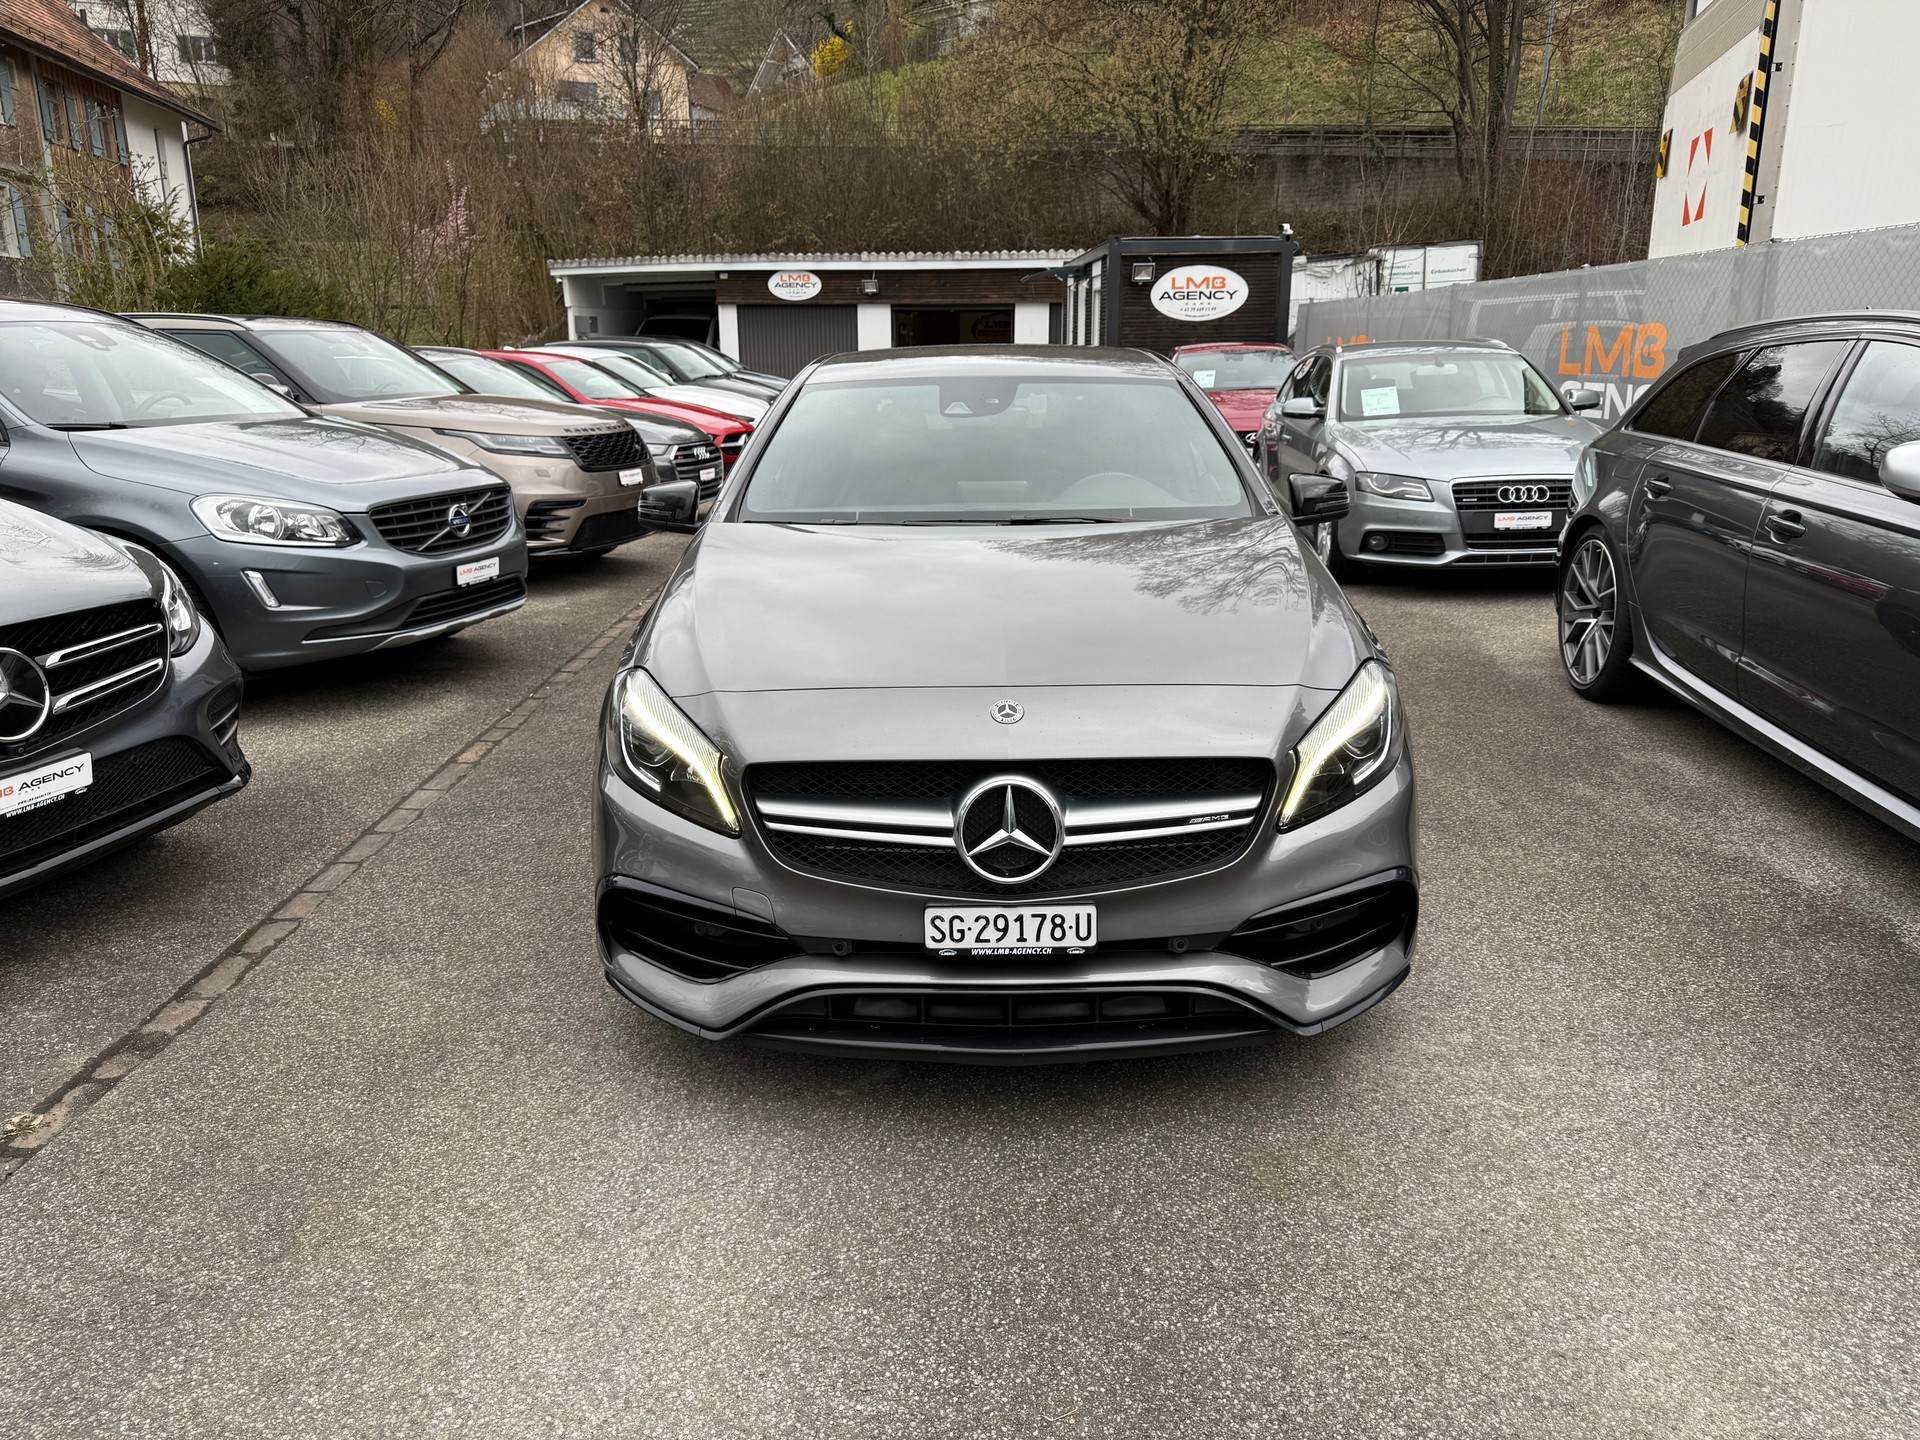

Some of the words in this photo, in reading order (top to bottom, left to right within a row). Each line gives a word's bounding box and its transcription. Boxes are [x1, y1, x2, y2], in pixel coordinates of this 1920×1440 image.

[780, 274, 811, 282] LMB
[1171, 276, 1226, 290] LMB
[1159, 290, 1239, 301] AGENCY
[1558, 322, 1667, 379] LMB
[474, 562, 497, 572] AGENCY
[18, 763, 84, 792] AGENCY
[6, 793, 65, 818] WWW.LMB-AGENCY.CH
[971, 947, 1053, 956] WWW.LMB-AGENCY.CH
